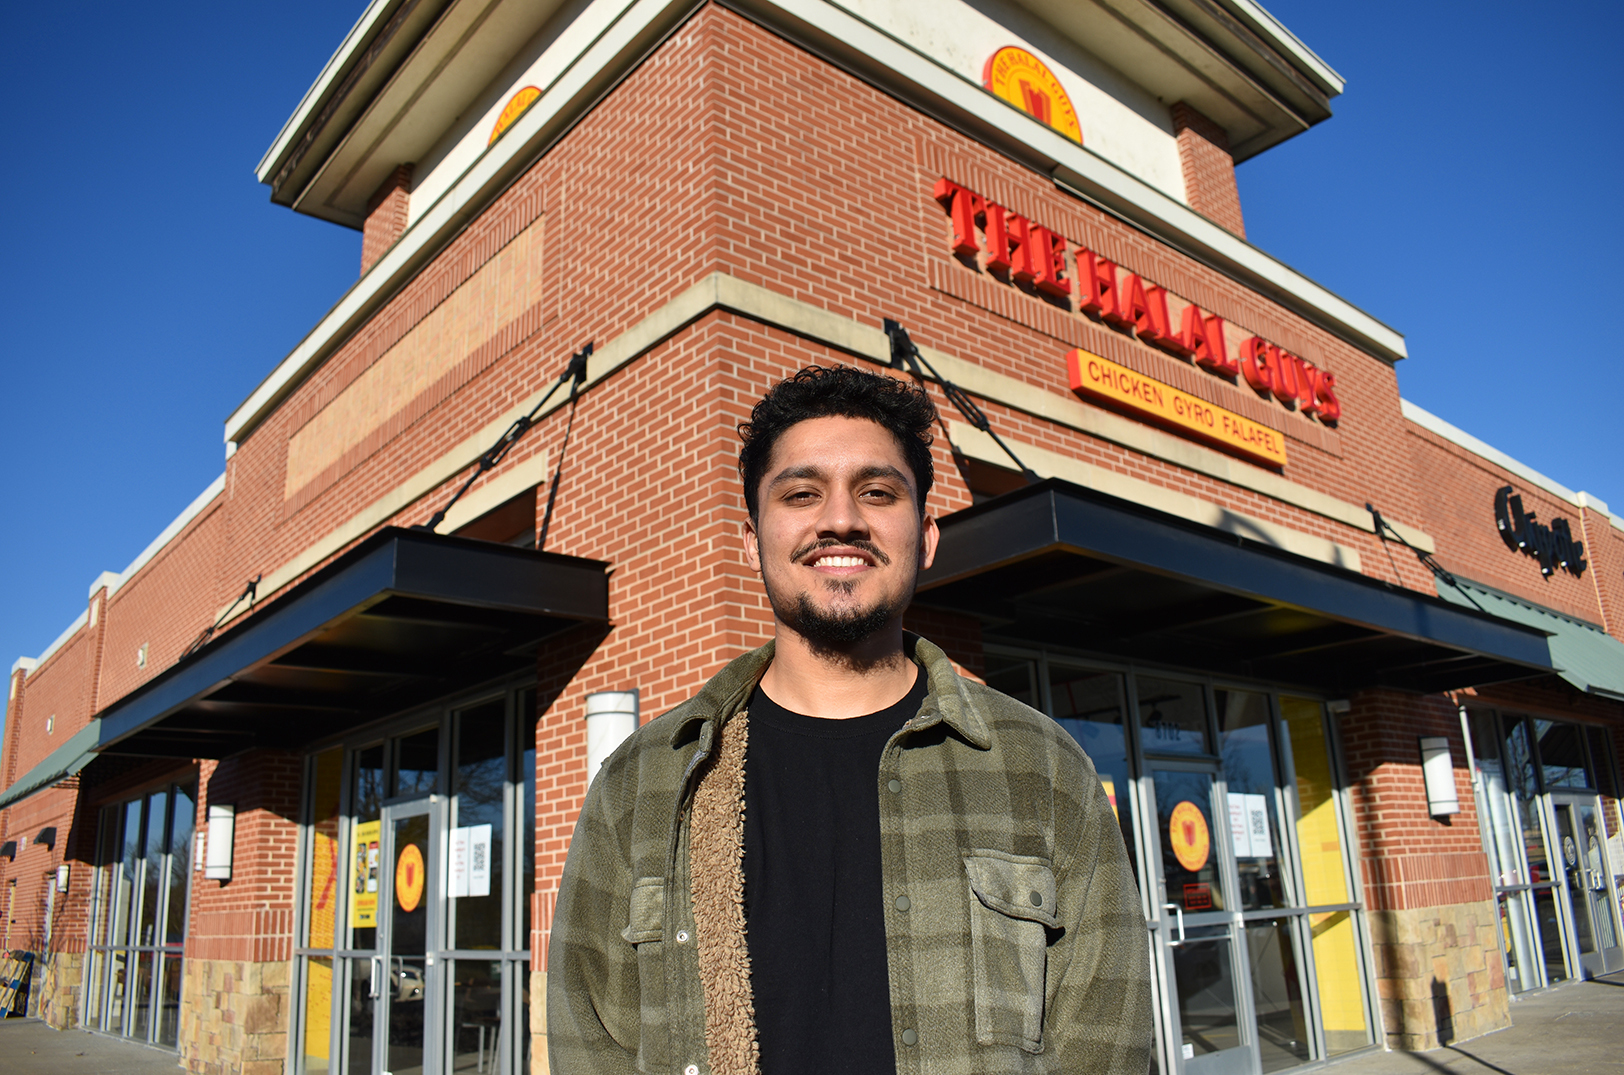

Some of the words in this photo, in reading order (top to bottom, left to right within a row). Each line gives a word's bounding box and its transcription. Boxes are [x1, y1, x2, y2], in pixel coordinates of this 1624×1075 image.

[995, 56, 1010, 86] THE
[934, 177, 1071, 298] THE
[1074, 246, 1239, 378] HALAL
[1240, 336, 1341, 421] GUYS
[1088, 361, 1164, 408] CHICKEN
[1173, 396, 1214, 428] GYRO
[1223, 415, 1280, 454] FALAFEL
